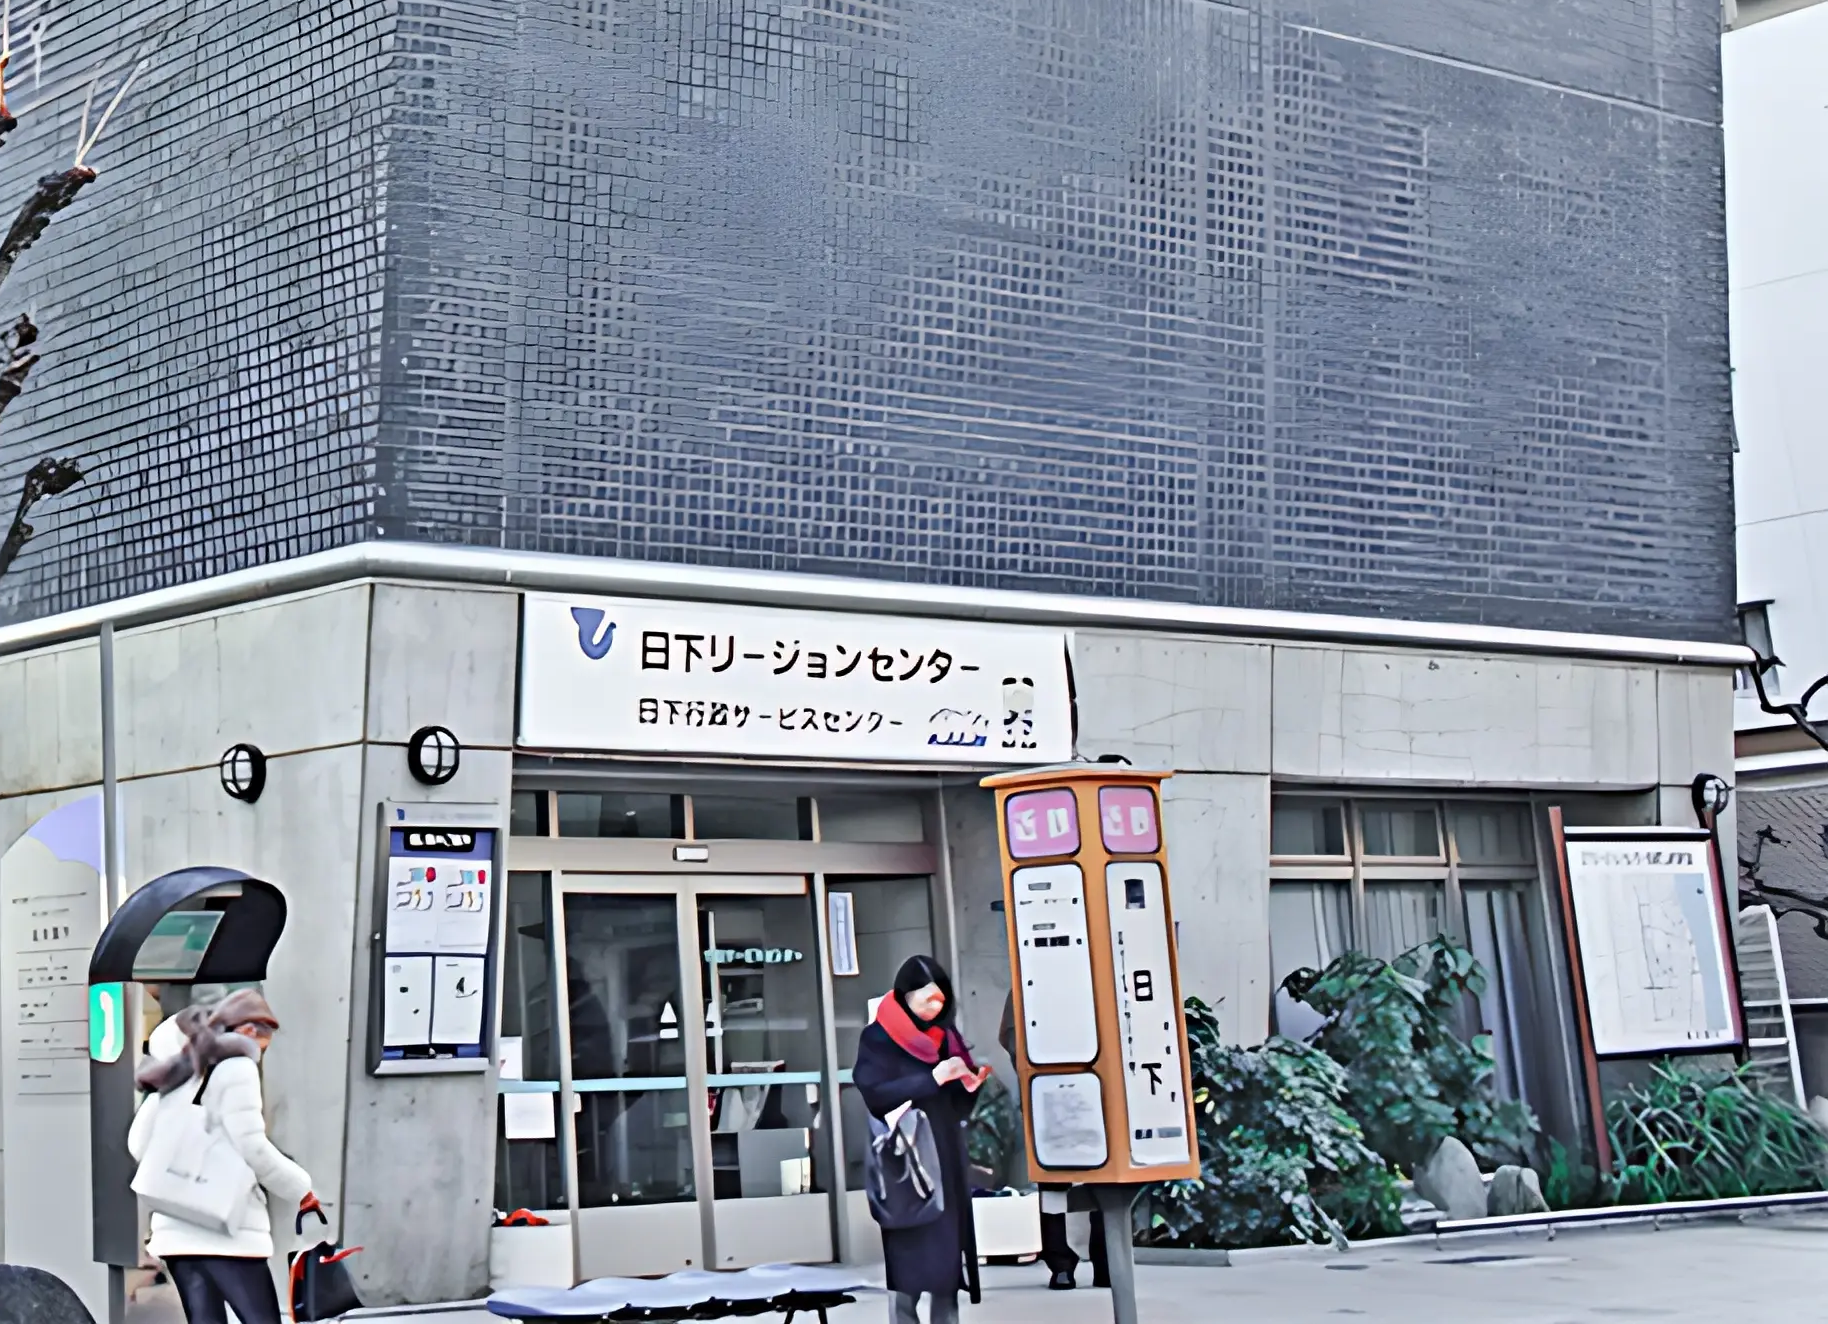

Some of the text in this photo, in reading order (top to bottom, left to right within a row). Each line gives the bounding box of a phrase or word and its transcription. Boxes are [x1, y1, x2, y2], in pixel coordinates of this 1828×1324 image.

[641, 630, 981, 684] 日下リージョンセンター
